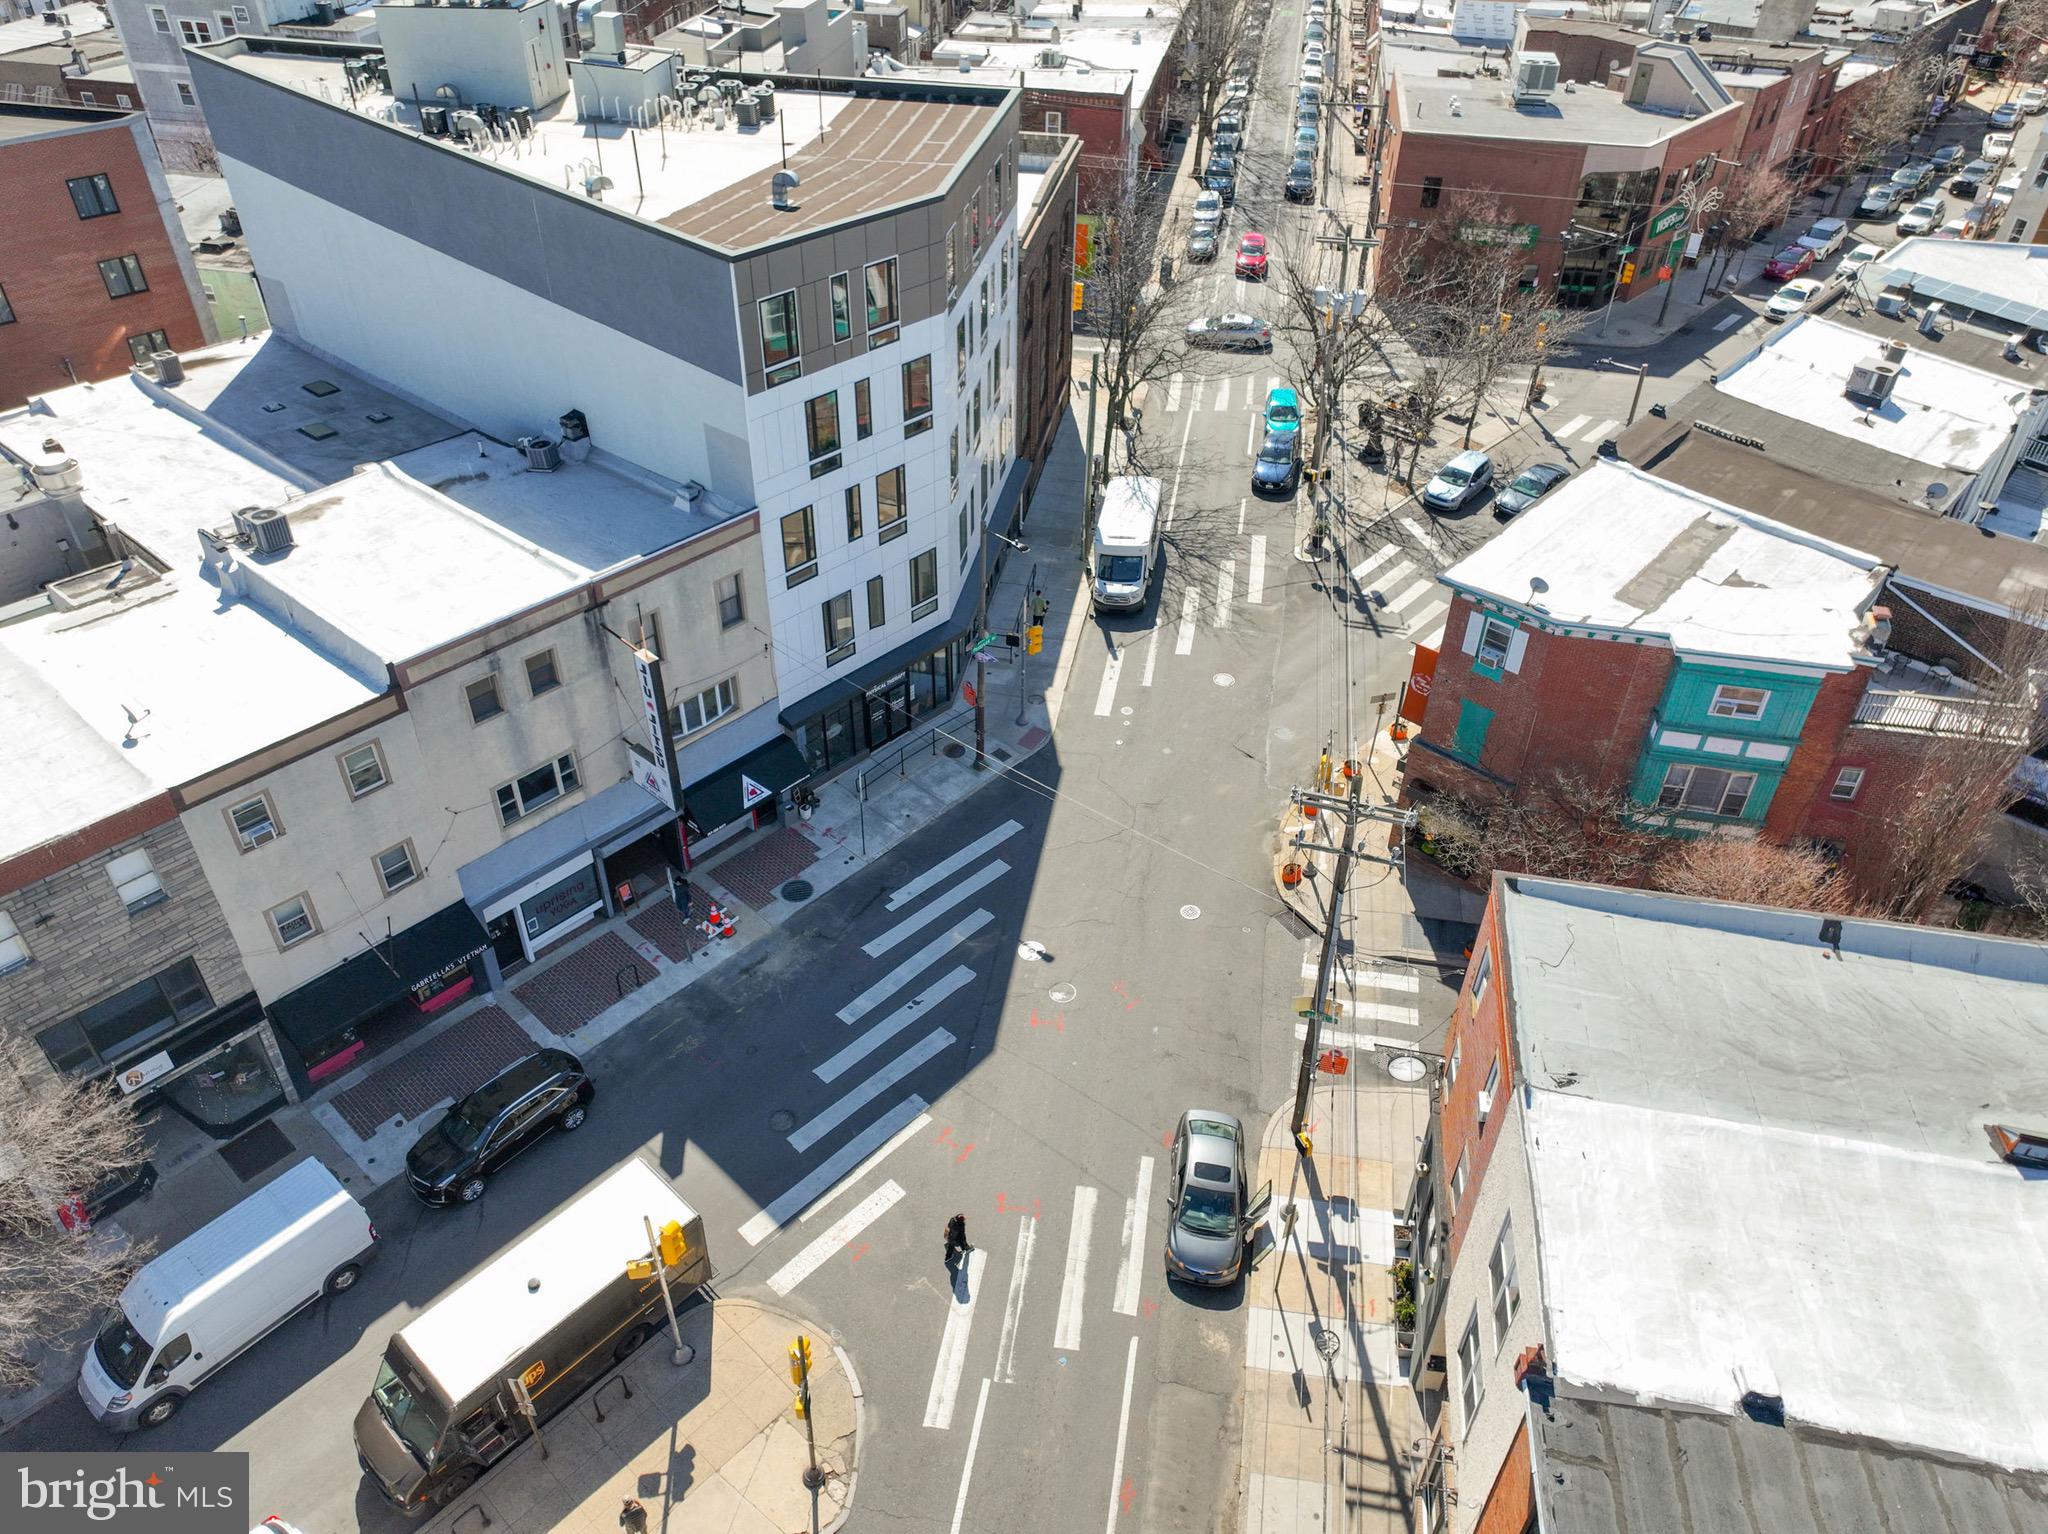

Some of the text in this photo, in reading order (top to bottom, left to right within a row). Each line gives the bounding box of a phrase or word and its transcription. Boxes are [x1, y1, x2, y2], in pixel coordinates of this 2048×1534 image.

[535, 881, 585, 914] uprising
[411, 943, 488, 992] GABRIELLA'S VIETNAM
